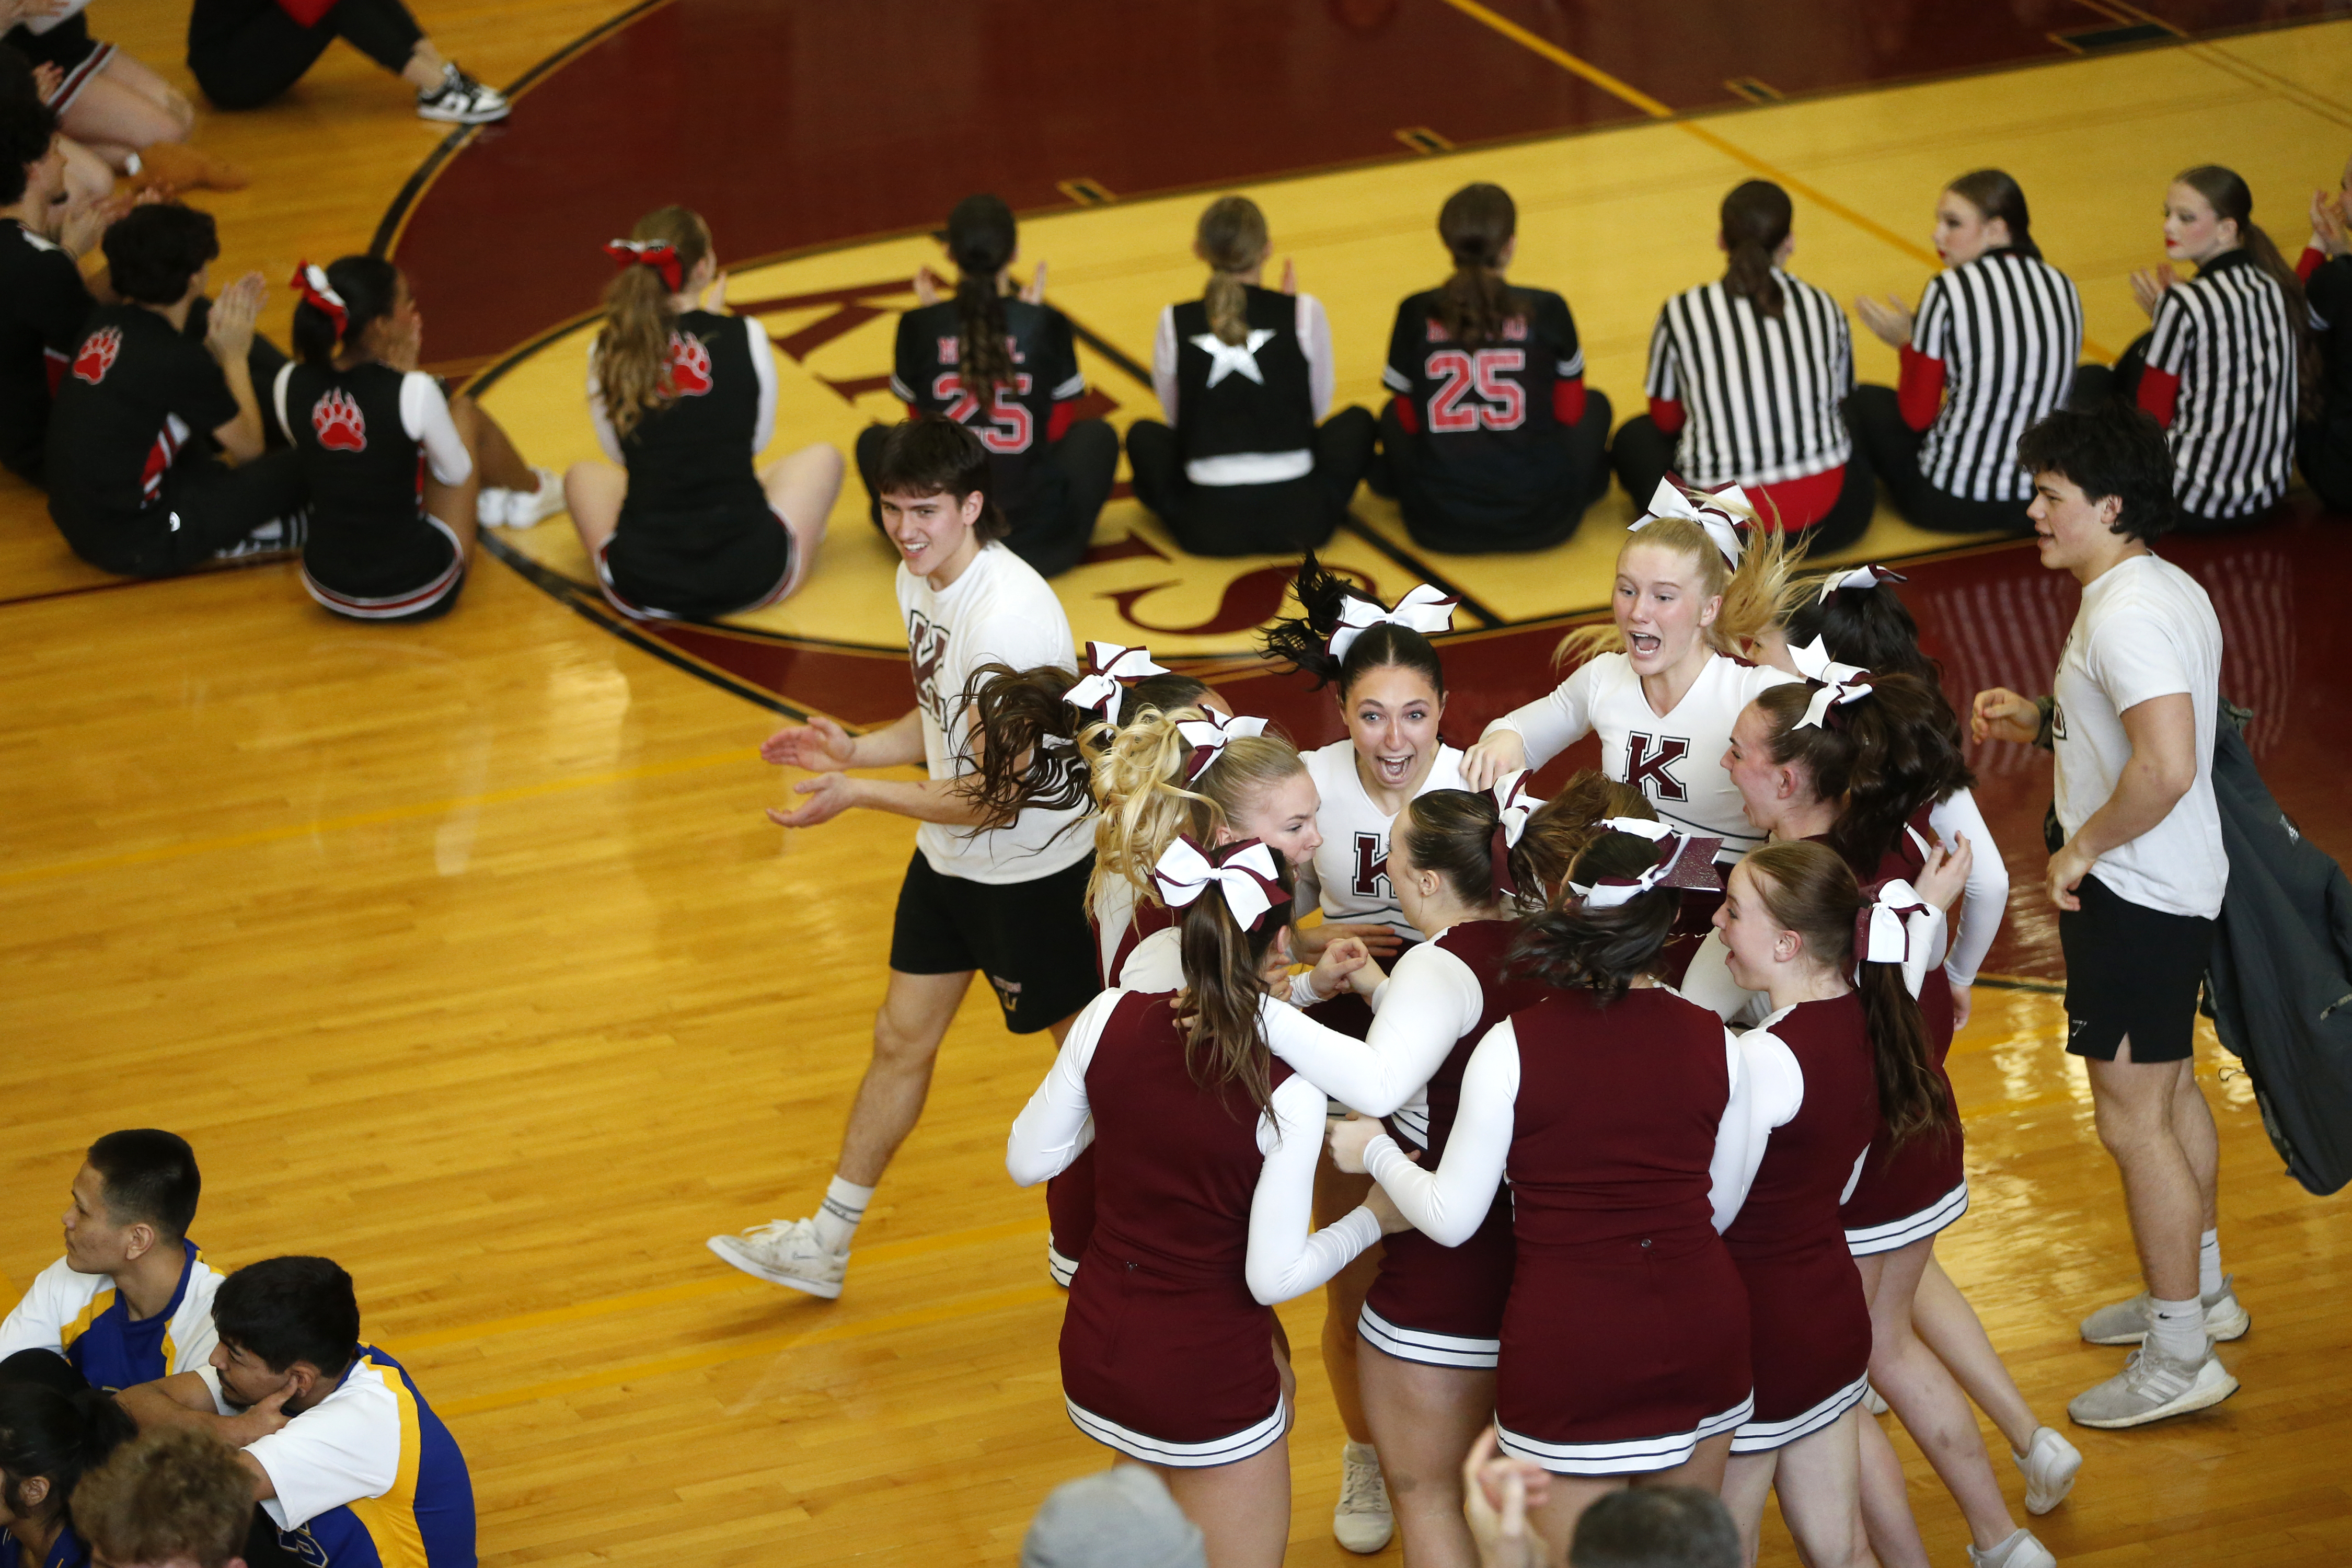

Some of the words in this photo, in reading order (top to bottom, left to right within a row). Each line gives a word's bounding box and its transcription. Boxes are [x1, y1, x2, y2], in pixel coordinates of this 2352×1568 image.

[932, 371, 1033, 454] 25
[1425, 348, 1526, 433] 25
[1622, 730, 1690, 802] K
